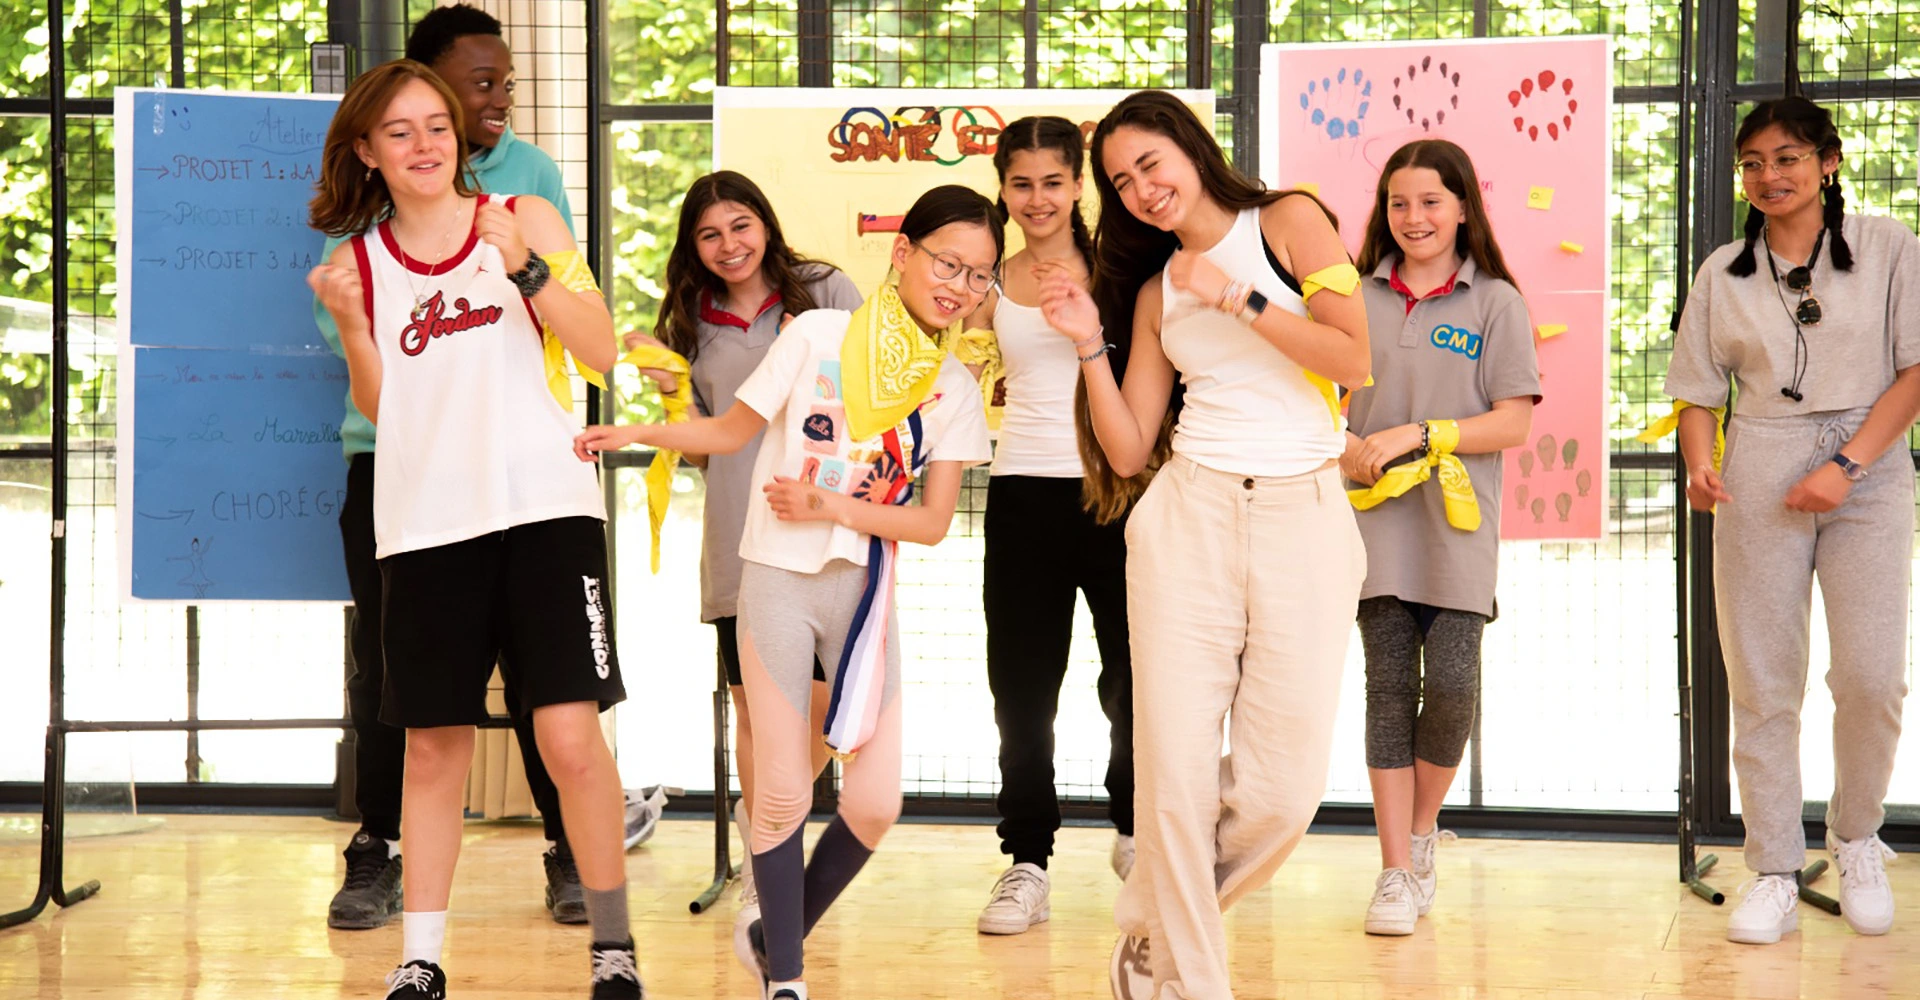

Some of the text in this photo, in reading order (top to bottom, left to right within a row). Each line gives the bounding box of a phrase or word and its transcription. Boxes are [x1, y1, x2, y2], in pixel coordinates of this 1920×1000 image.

[828, 110, 1003, 163] SANTÉ ET
[172, 155, 253, 181] PROJET
[174, 202, 257, 226] PROJET
[174, 246, 258, 270] PROJET
[400, 289, 504, 357] Jordan
[1432, 326, 1481, 357] CMJ
[187, 413, 233, 444] La
[582, 575, 610, 680] CONNECT
